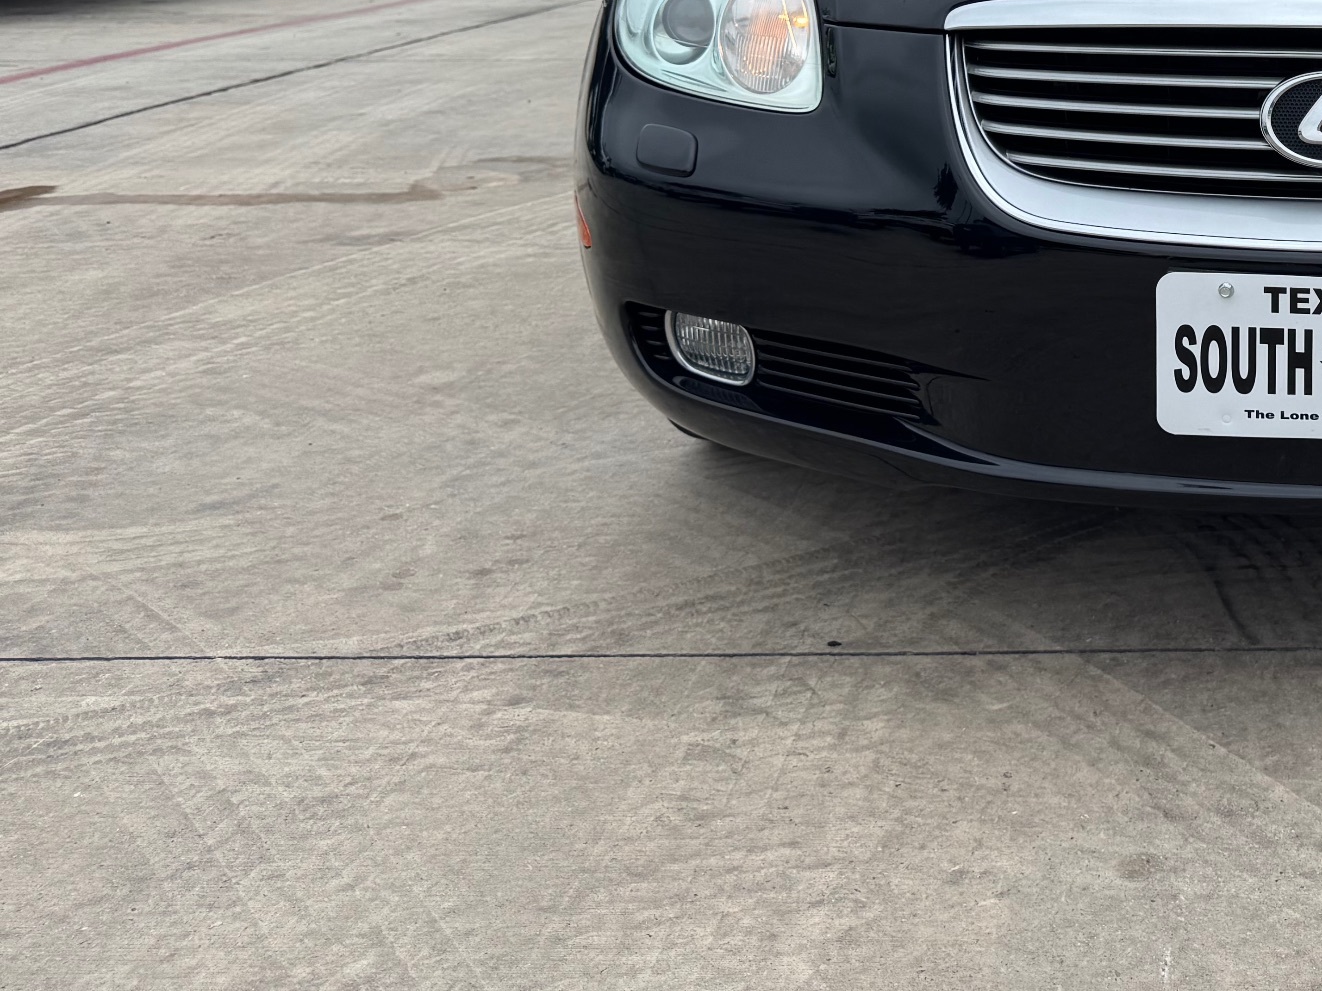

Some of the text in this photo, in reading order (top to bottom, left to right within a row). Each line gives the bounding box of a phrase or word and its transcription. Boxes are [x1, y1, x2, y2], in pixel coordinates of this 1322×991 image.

[1173, 324, 1314, 396] SOUTH
[1244, 409, 1275, 420] The
[1280, 410, 1320, 421] Lone
